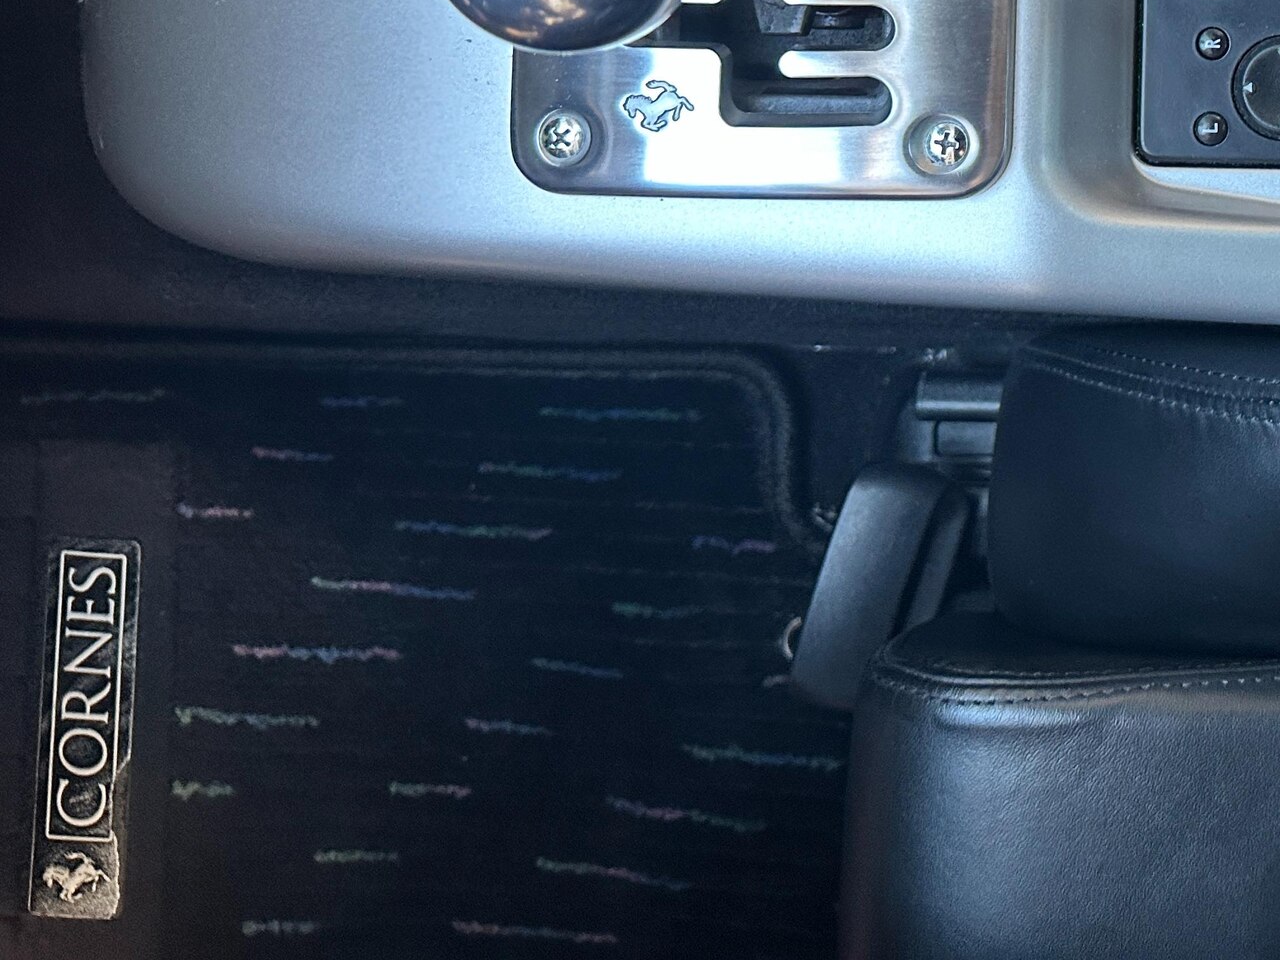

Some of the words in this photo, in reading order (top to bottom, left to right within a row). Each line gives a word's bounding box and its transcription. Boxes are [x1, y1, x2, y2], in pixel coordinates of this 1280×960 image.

[1205, 38, 1221, 49] R
[1201, 122, 1219, 134] L
[56, 566, 118, 828] CORNES
